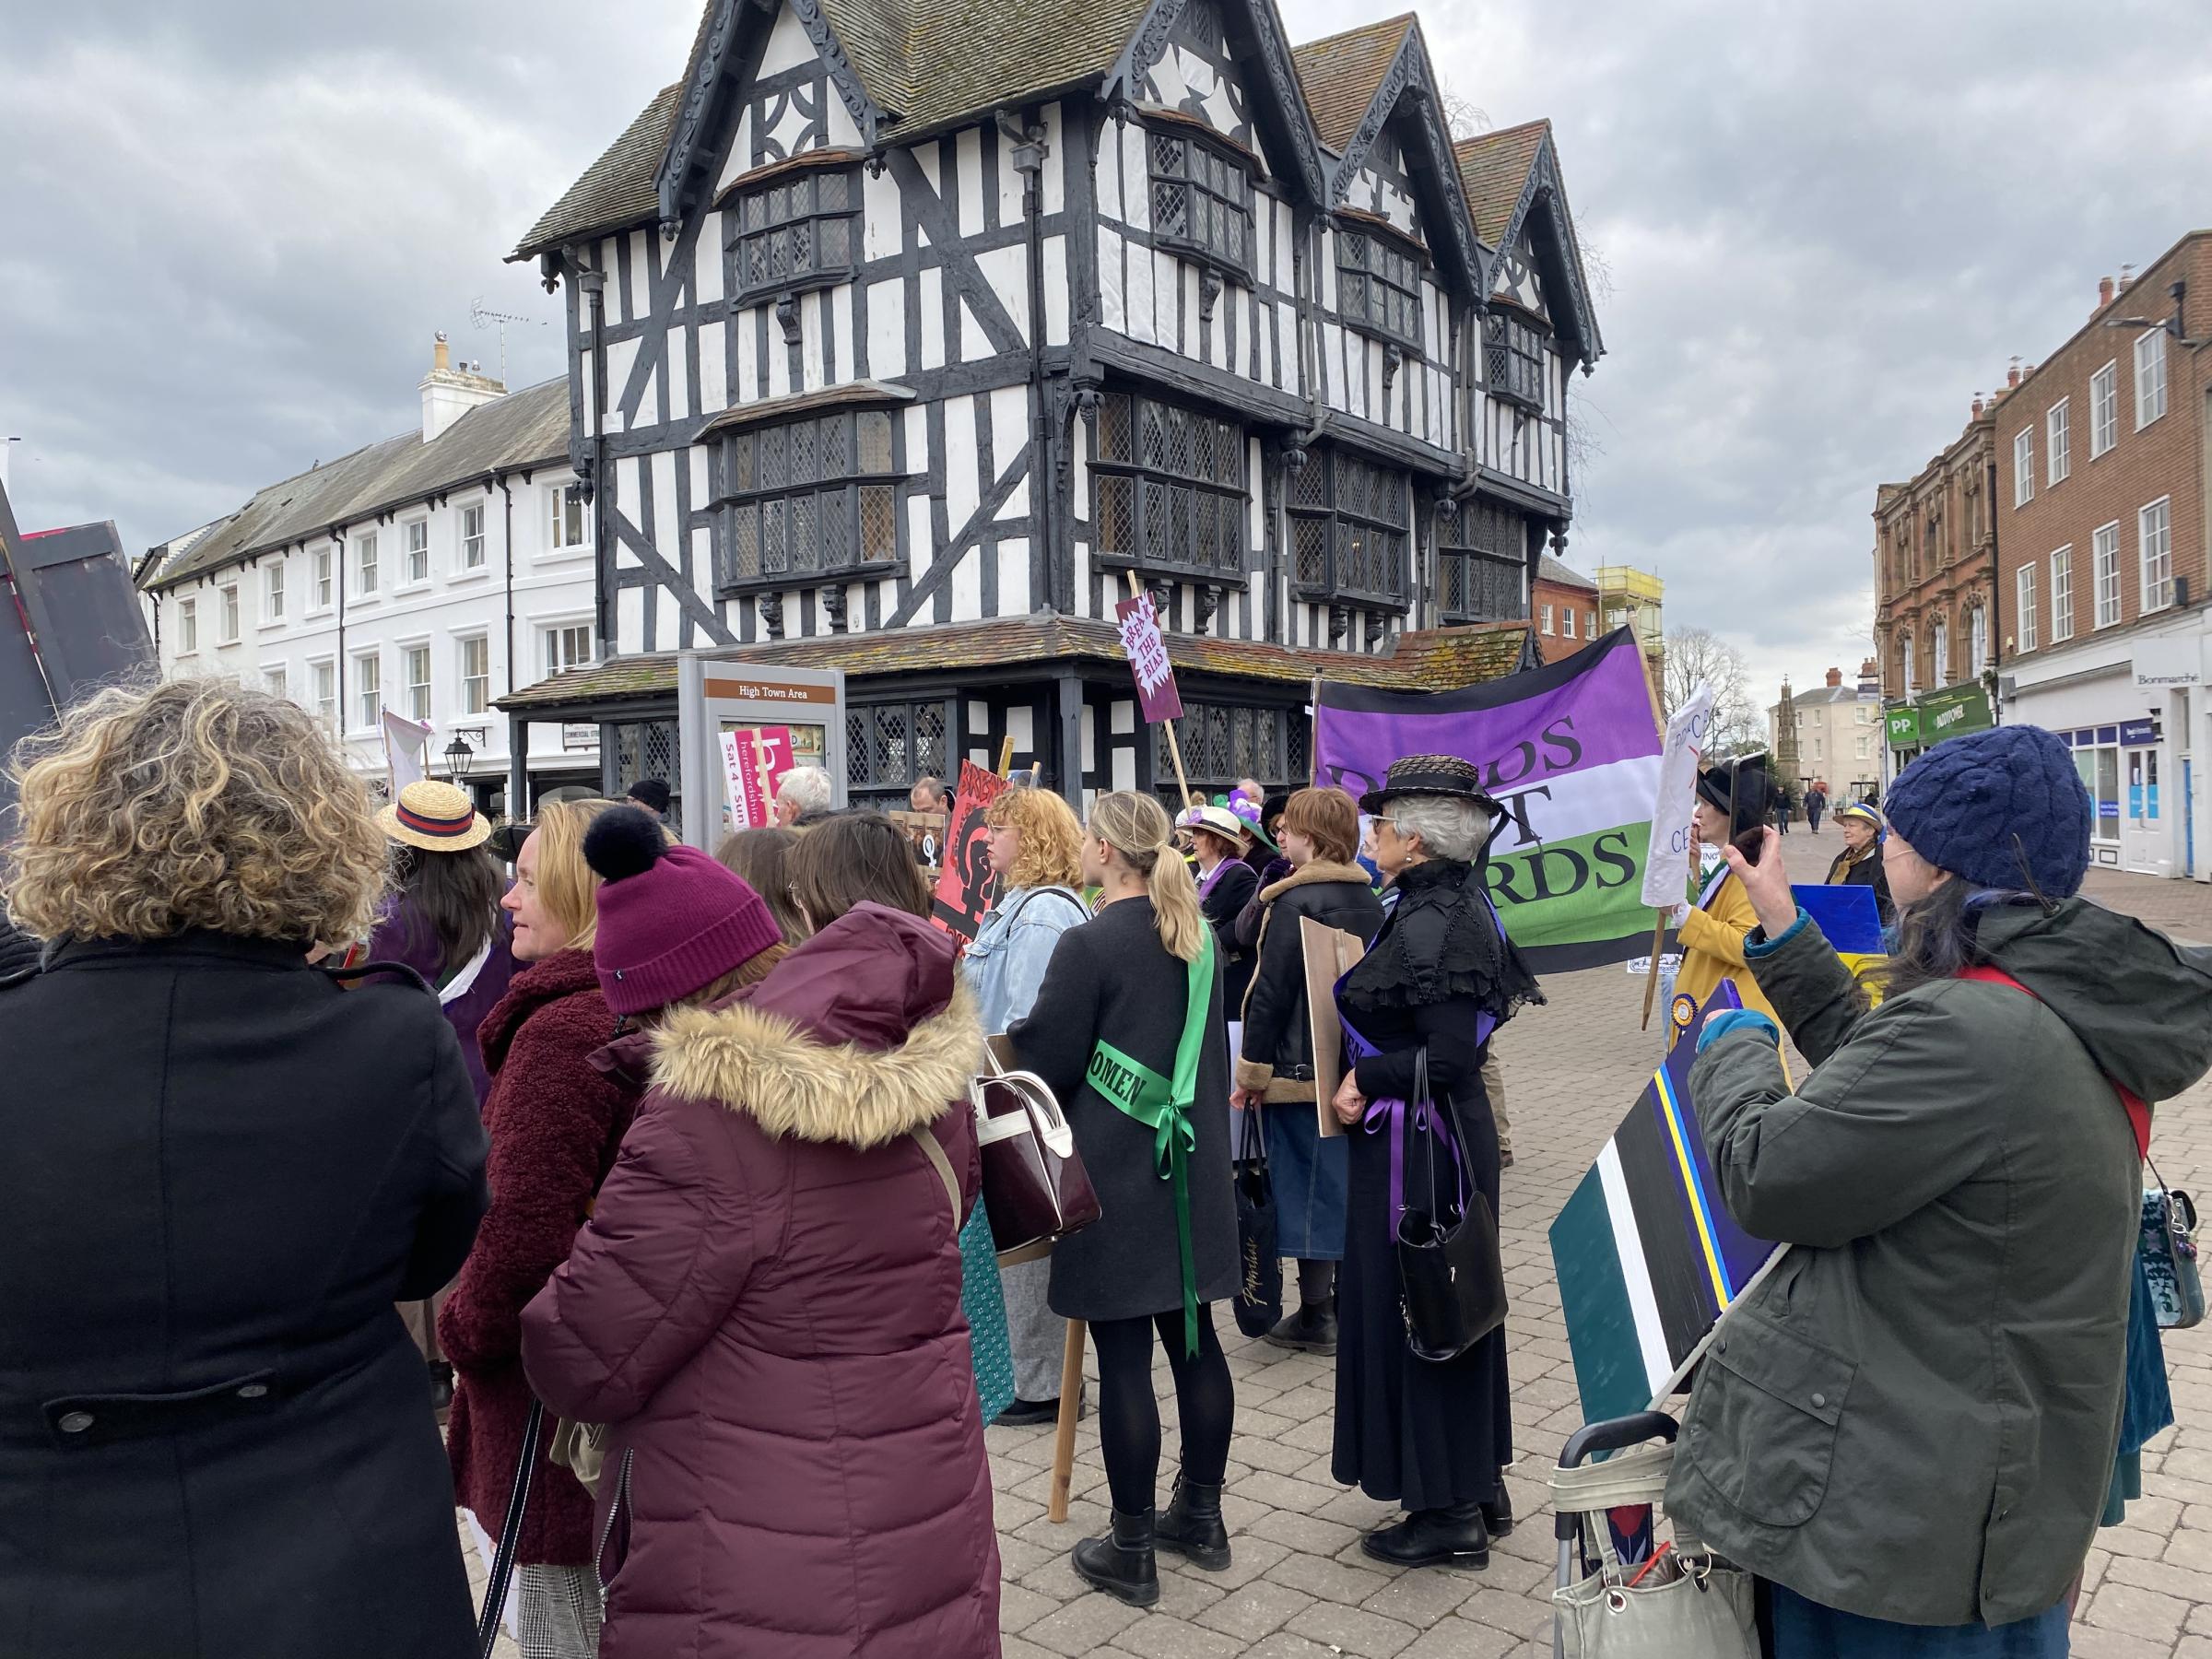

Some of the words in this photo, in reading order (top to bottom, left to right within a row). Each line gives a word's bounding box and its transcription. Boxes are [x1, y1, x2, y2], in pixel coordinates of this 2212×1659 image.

[1126, 604, 1151, 651] BREAK
[1138, 632, 1157, 660] THE
[1144, 648, 1163, 678] BIAS
[739, 686, 759, 699] High
[762, 687, 786, 698] Town
[788, 688, 807, 700] Area
[2138, 673, 2199, 685] Bonmarché
[726, 744, 736, 768] Sat
[732, 772, 739, 781] 4
[740, 741, 759, 823] herefordshire
[735, 795, 745, 823] Sun
[1484, 831, 1637, 908] RDS
[1090, 1051, 1147, 1106] OMEN
